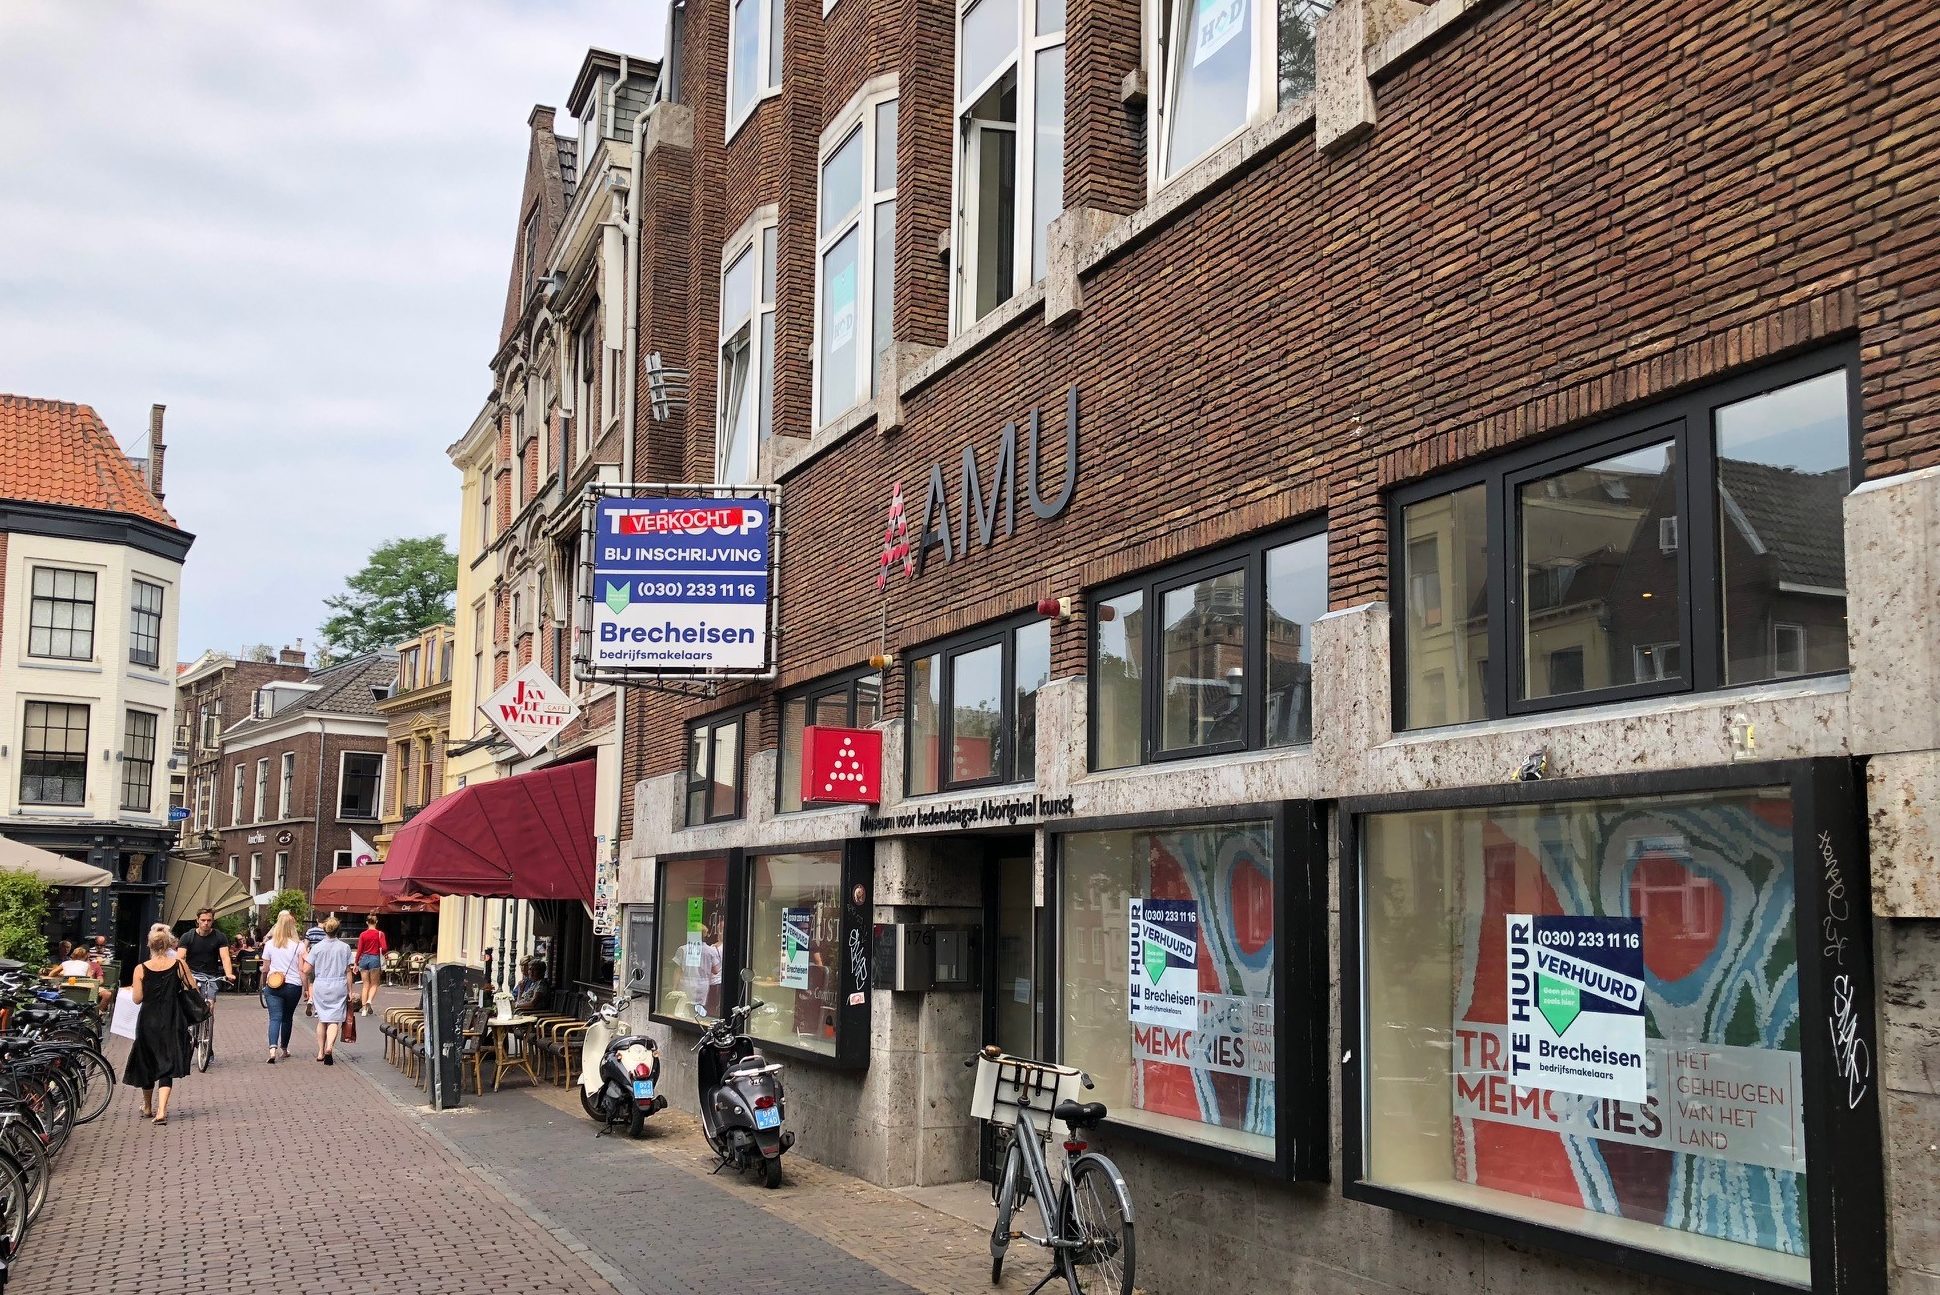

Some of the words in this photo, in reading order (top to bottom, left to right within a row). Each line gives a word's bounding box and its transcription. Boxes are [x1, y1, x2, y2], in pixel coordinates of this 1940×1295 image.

[632, 510, 731, 532] VERKOCHT
[604, 548, 631, 561] BIJ
[636, 548, 762, 562] INSCHRIJVING
[638, 582, 682, 597] (030)
[686, 584, 716, 597] 233
[720, 584, 734, 597] 11
[738, 584, 756, 597] 16
[601, 621, 755, 644] Brecheisen
[600, 649, 713, 661] bedrijfsmakelaars
[860, 815, 895, 832] Museum
[896, 814, 916, 828] voor
[980, 797, 1036, 825] Aboriginal
[1040, 794, 1074, 816] kunst
[1165, 911, 1179, 921] 233
[906, 930, 932, 946] 176
[1131, 904, 1142, 975] HUUR
[1142, 924, 1193, 958] VERHUURD
[1538, 930, 1574, 947] (030)
[1578, 932, 1604, 947] 233
[1607, 933, 1620, 947] 11
[1624, 934, 1640, 948] 16
[1511, 923, 1530, 1021] HUUR
[1537, 950, 1637, 1002] VERHUURD
[1131, 983, 1140, 1014] TE
[1144, 988, 1196, 1006] Brecheisen
[1252, 1039, 1271, 1055] VAN
[1512, 1033, 1530, 1076] TE
[1539, 1040, 1641, 1068] Brecheisen
[1540, 1062, 1614, 1080] bedrijfsmakelaars
[1676, 1051, 1710, 1070] HET
[1677, 1076, 1784, 1105] GEHEUGEN
[1678, 1101, 1713, 1122] VAN
[1720, 1107, 1757, 1128] HET
[1679, 1126, 1728, 1150] LAND
